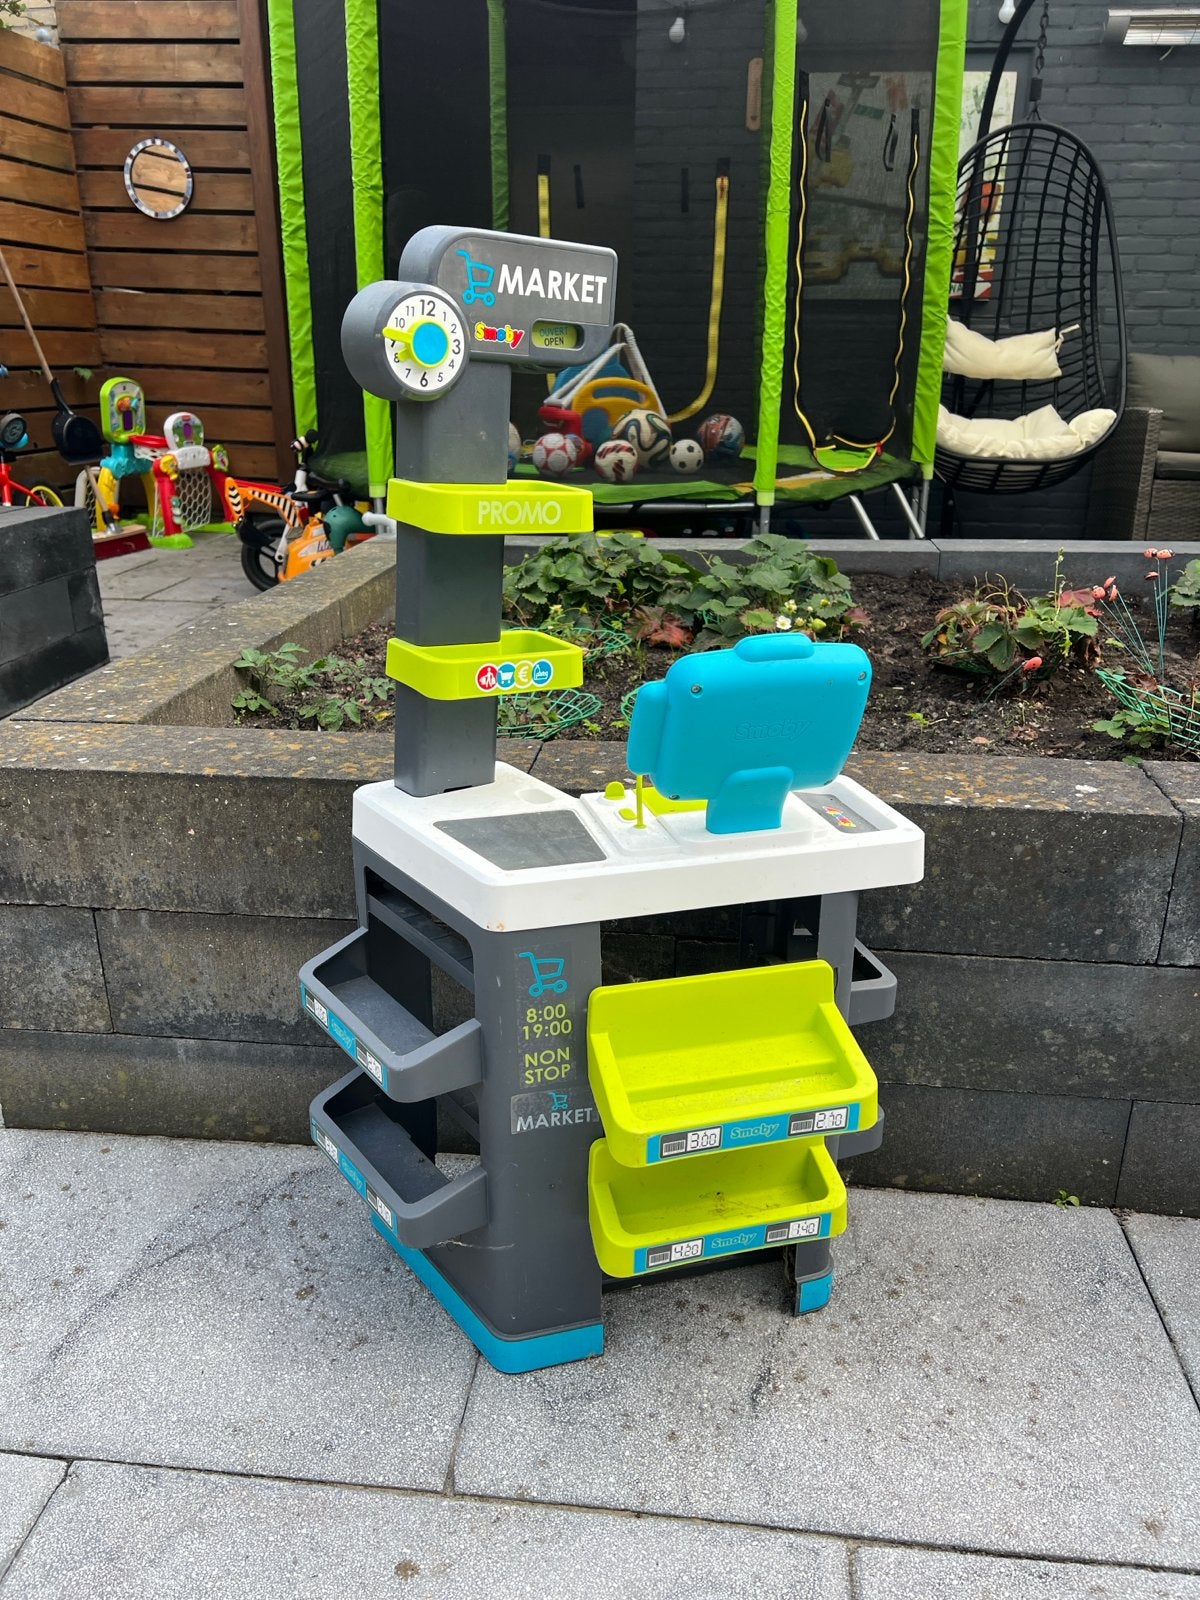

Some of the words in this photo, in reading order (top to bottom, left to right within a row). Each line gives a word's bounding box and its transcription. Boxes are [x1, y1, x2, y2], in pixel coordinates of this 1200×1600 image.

[498, 264, 607, 304] MARKET
[406, 305, 415, 317] 11
[420, 299, 436, 317] 12
[395, 317, 406, 329] 10
[443, 311, 447, 322] 1
[450, 323, 457, 334] 2
[474, 321, 525, 349] Smoby
[540, 326, 569, 337] OUVERT
[452, 339, 461, 355] 3
[544, 336, 564, 347] OPEN
[448, 360, 455, 369] 4
[405, 368, 411, 379] 7
[420, 371, 428, 387] 6
[437, 372, 443, 383] 5
[478, 500, 562, 525] PROMO
[732, 716, 814, 743] Smoby
[526, 1003, 566, 1024] 8:00
[522, 1018, 572, 1040] 19:00
[525, 1047, 570, 1068] NON
[525, 1063, 571, 1085] STOP
[516, 1107, 593, 1132] MARKET
[730, 1122, 779, 1139] Smoby
[711, 1232, 757, 1248] Smoby
